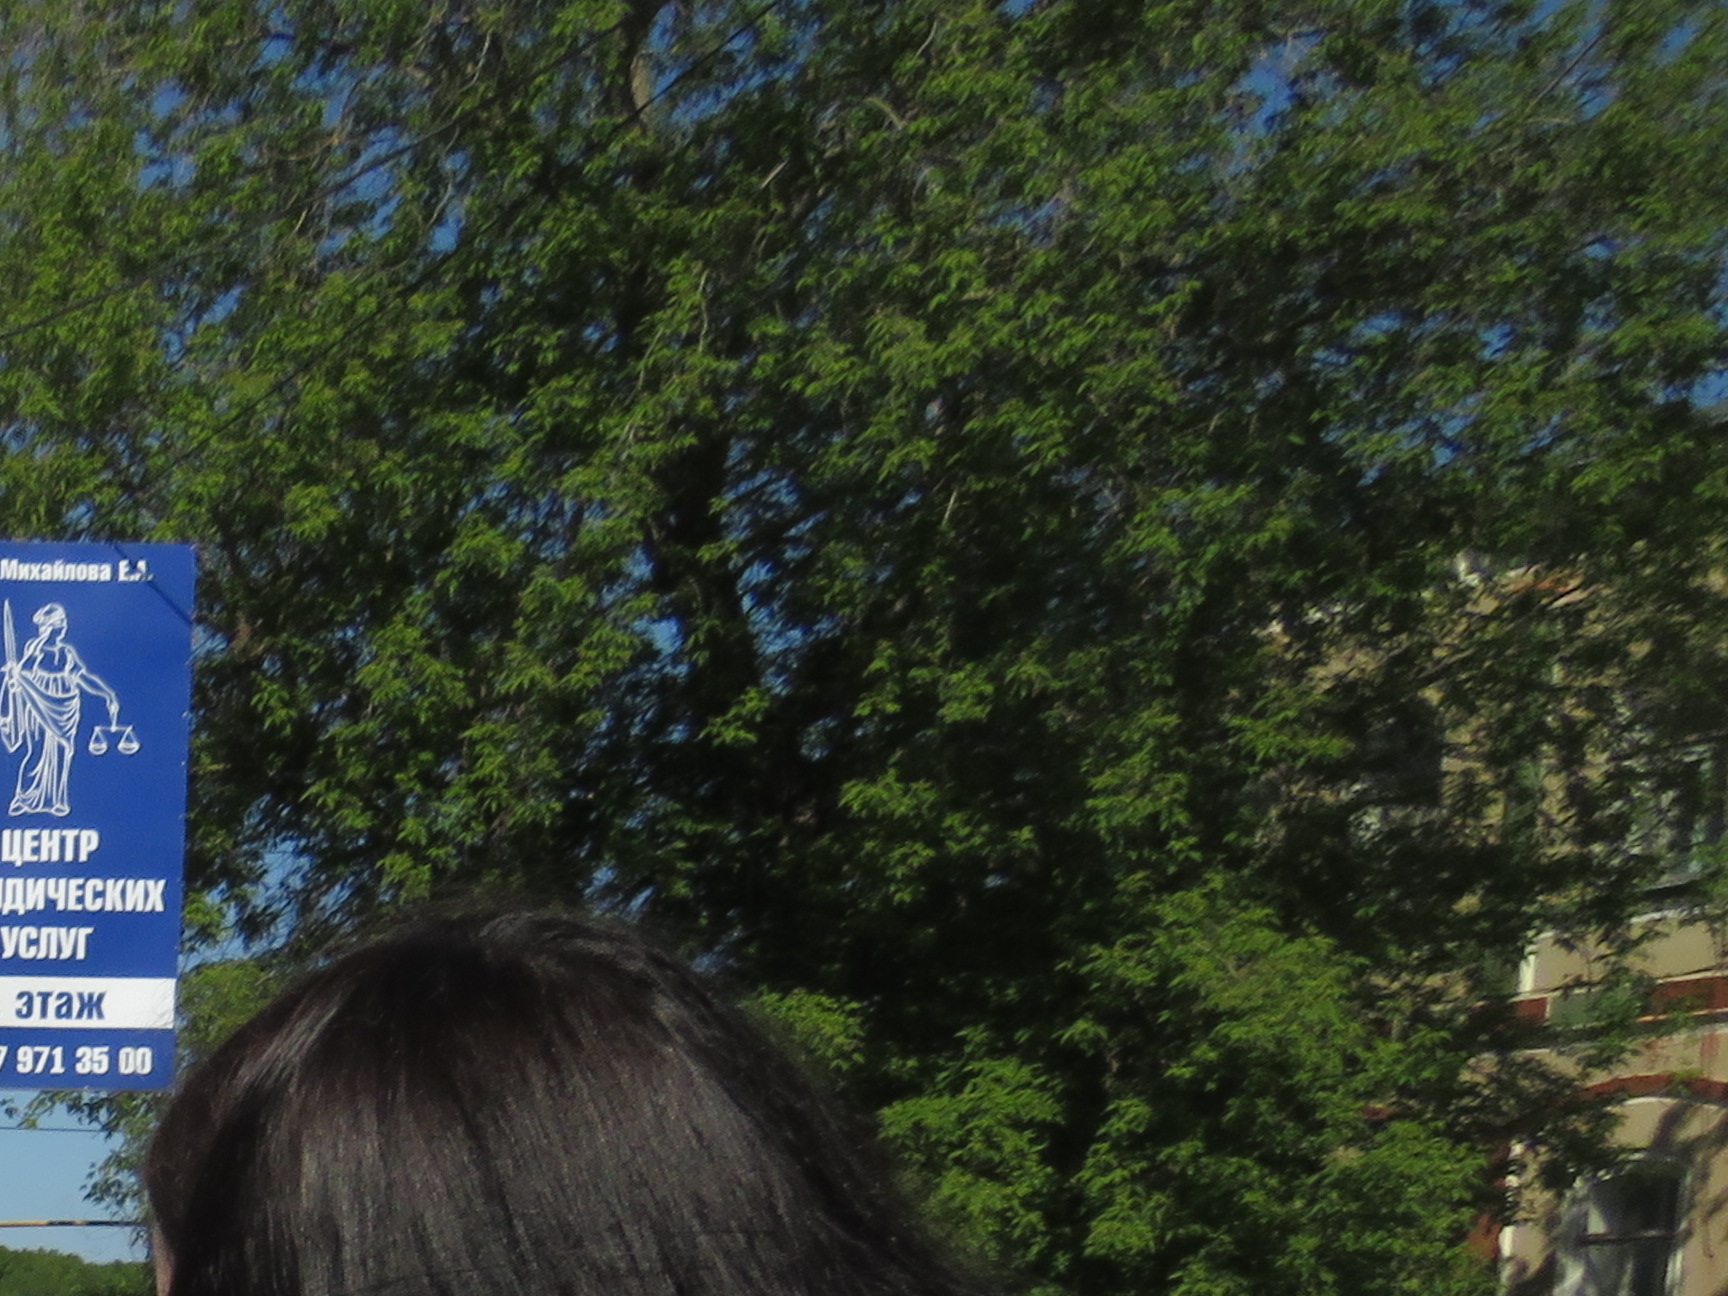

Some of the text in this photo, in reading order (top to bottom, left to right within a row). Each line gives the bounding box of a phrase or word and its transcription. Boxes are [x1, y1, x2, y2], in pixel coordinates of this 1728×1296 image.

[0, 557, 113, 582] Михайлова
[0, 828, 100, 868] ЦЕНТР
[0, 926, 95, 960] УСЛУГ
[15, 990, 107, 1021] этаж
[16, 1045, 66, 1075] 971
[75, 1045, 110, 1075] 35
[118, 1046, 154, 1076] 00
